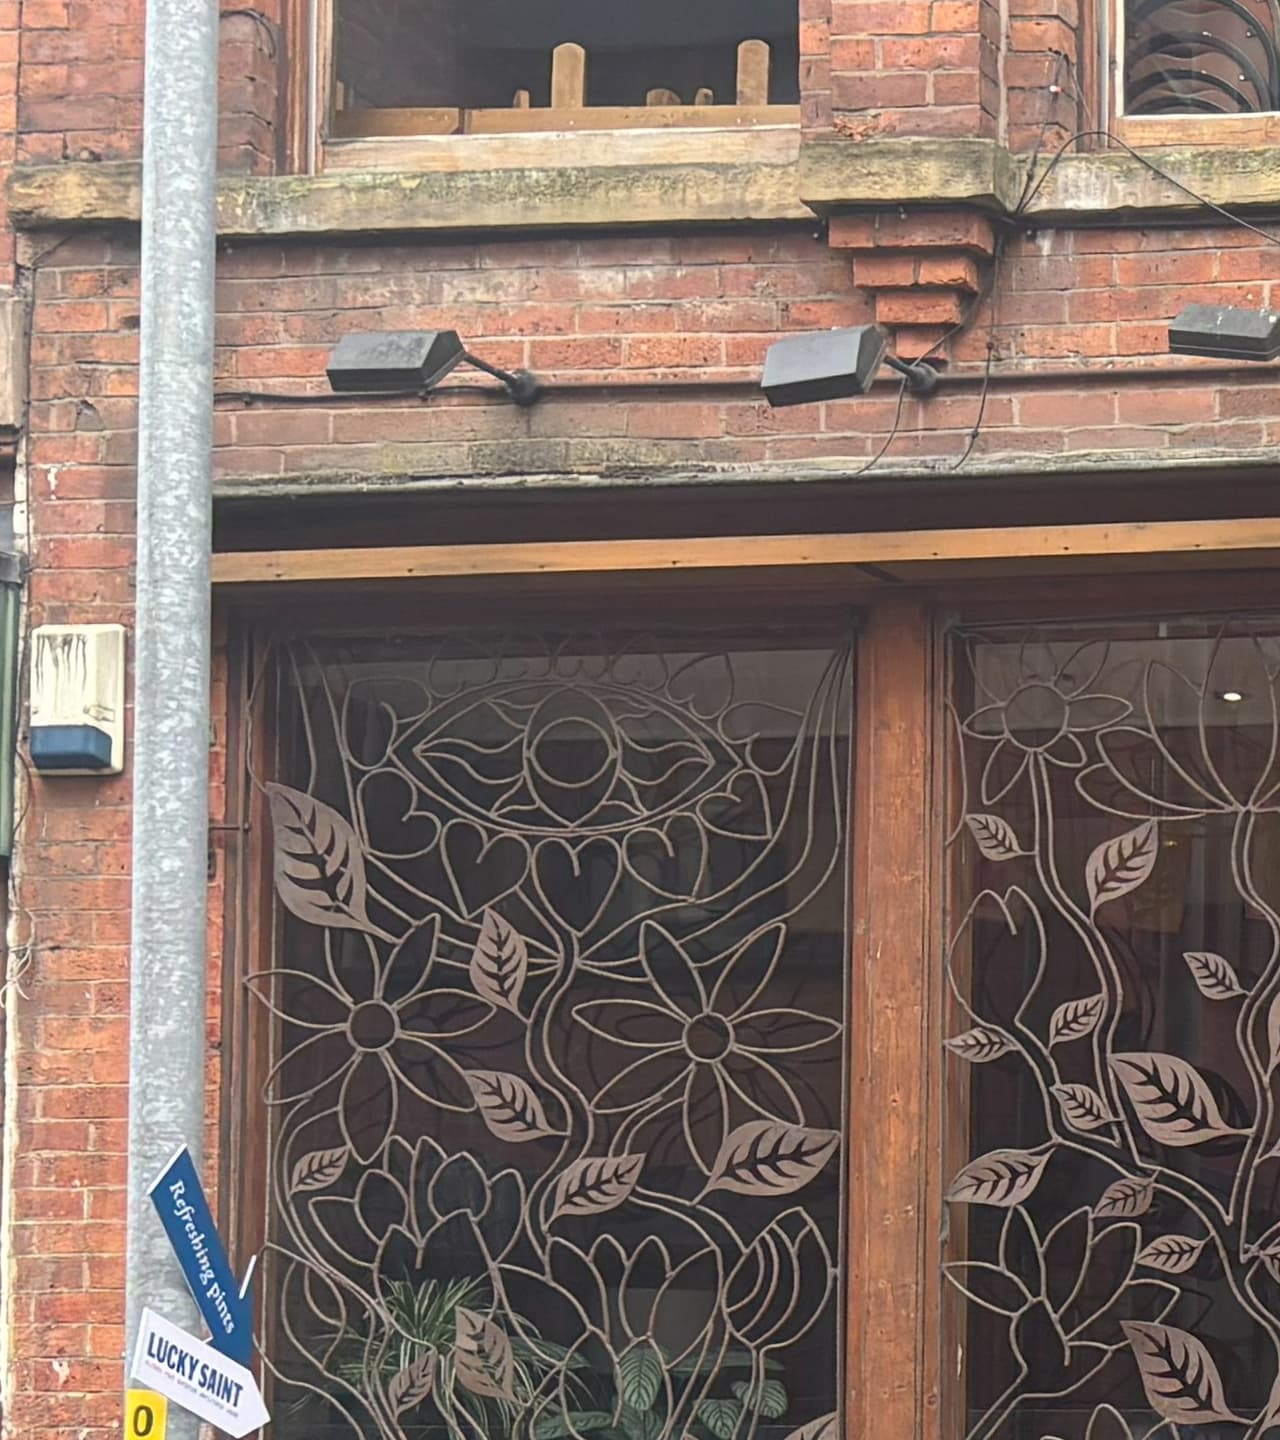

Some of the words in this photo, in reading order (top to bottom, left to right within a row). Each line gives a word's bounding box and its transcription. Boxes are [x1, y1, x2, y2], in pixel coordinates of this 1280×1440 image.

[169, 1179, 215, 1285] Refreshing
[206, 1282, 235, 1334] pints
[147, 1331, 199, 1381] LUCKY
[198, 1363, 244, 1408] SAINT
